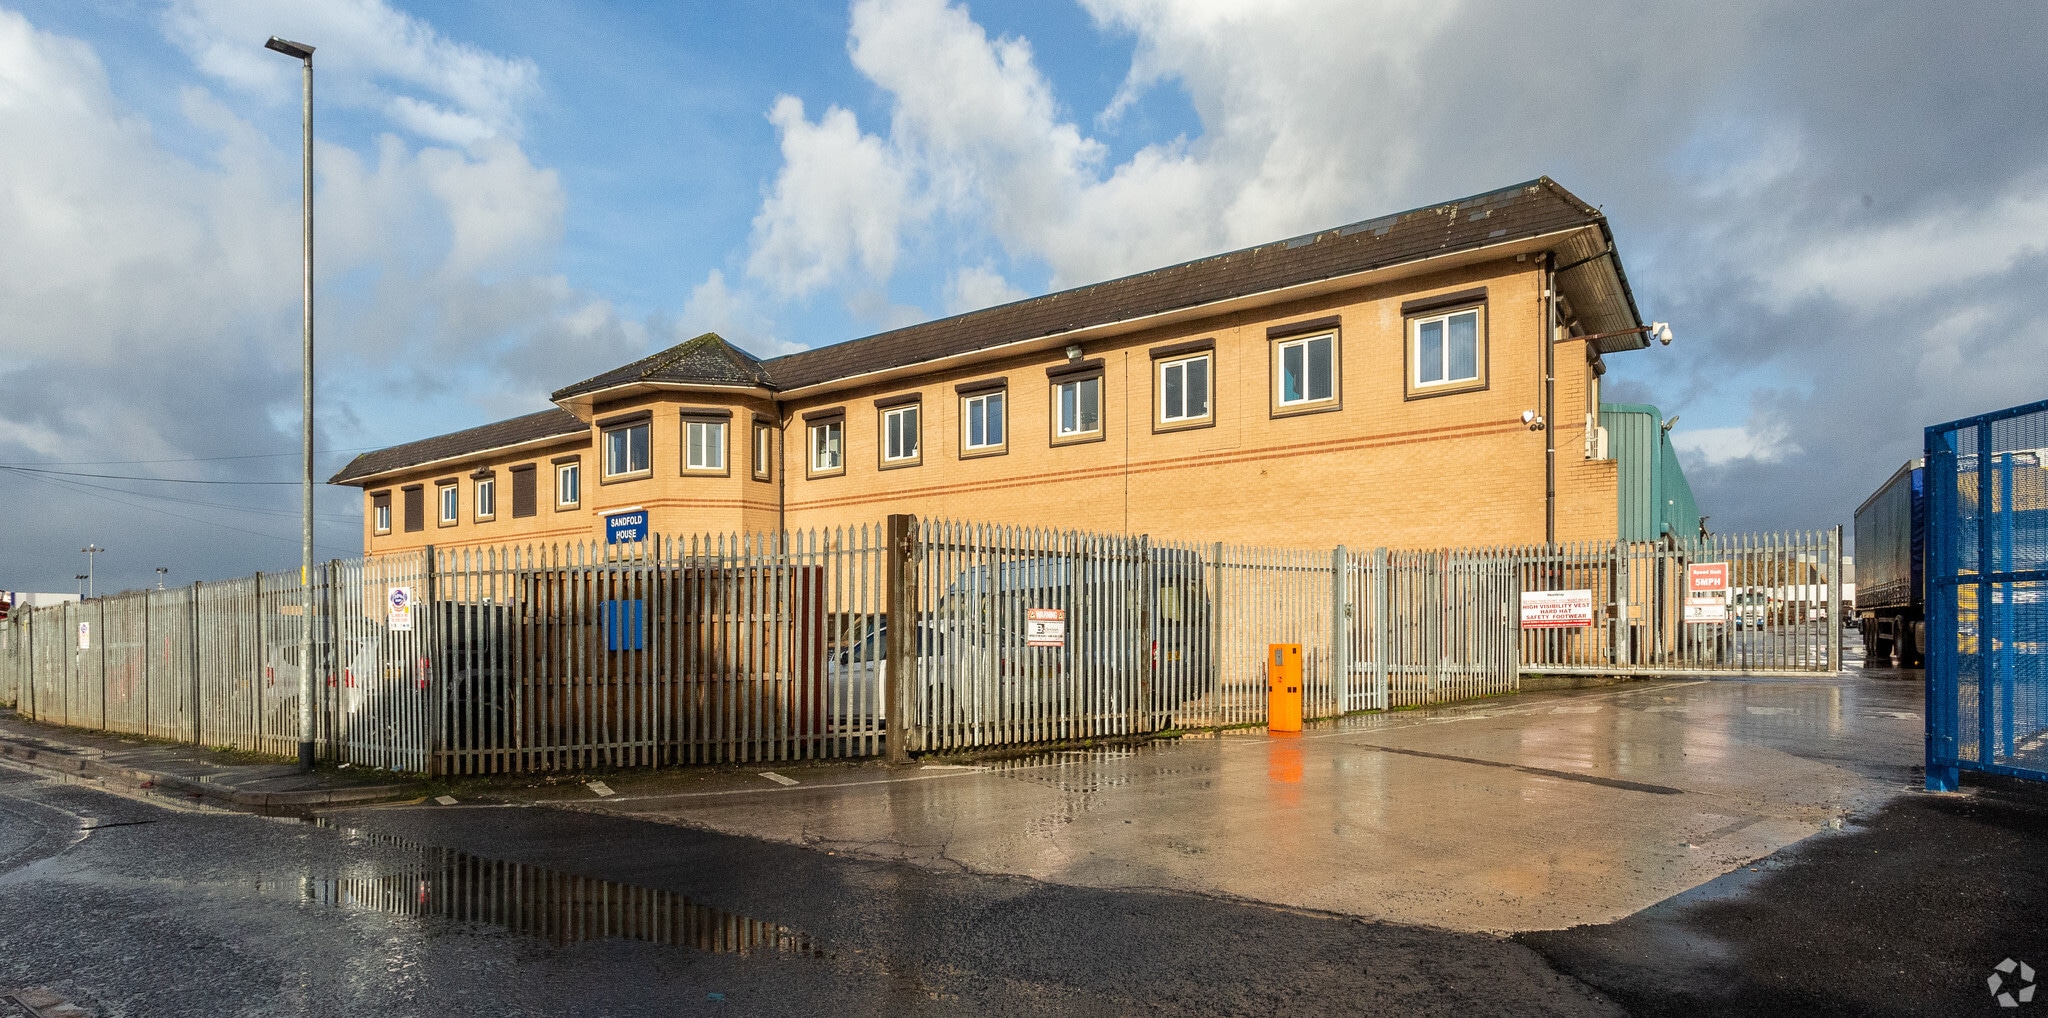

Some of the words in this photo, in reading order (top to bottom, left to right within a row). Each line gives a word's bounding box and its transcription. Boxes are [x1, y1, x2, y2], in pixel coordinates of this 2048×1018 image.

[611, 515, 642, 527] SANDFOLD
[616, 529, 636, 539] HOUSE
[1695, 578, 1720, 586] 5MPH
[1035, 611, 1057, 619] WARNING
